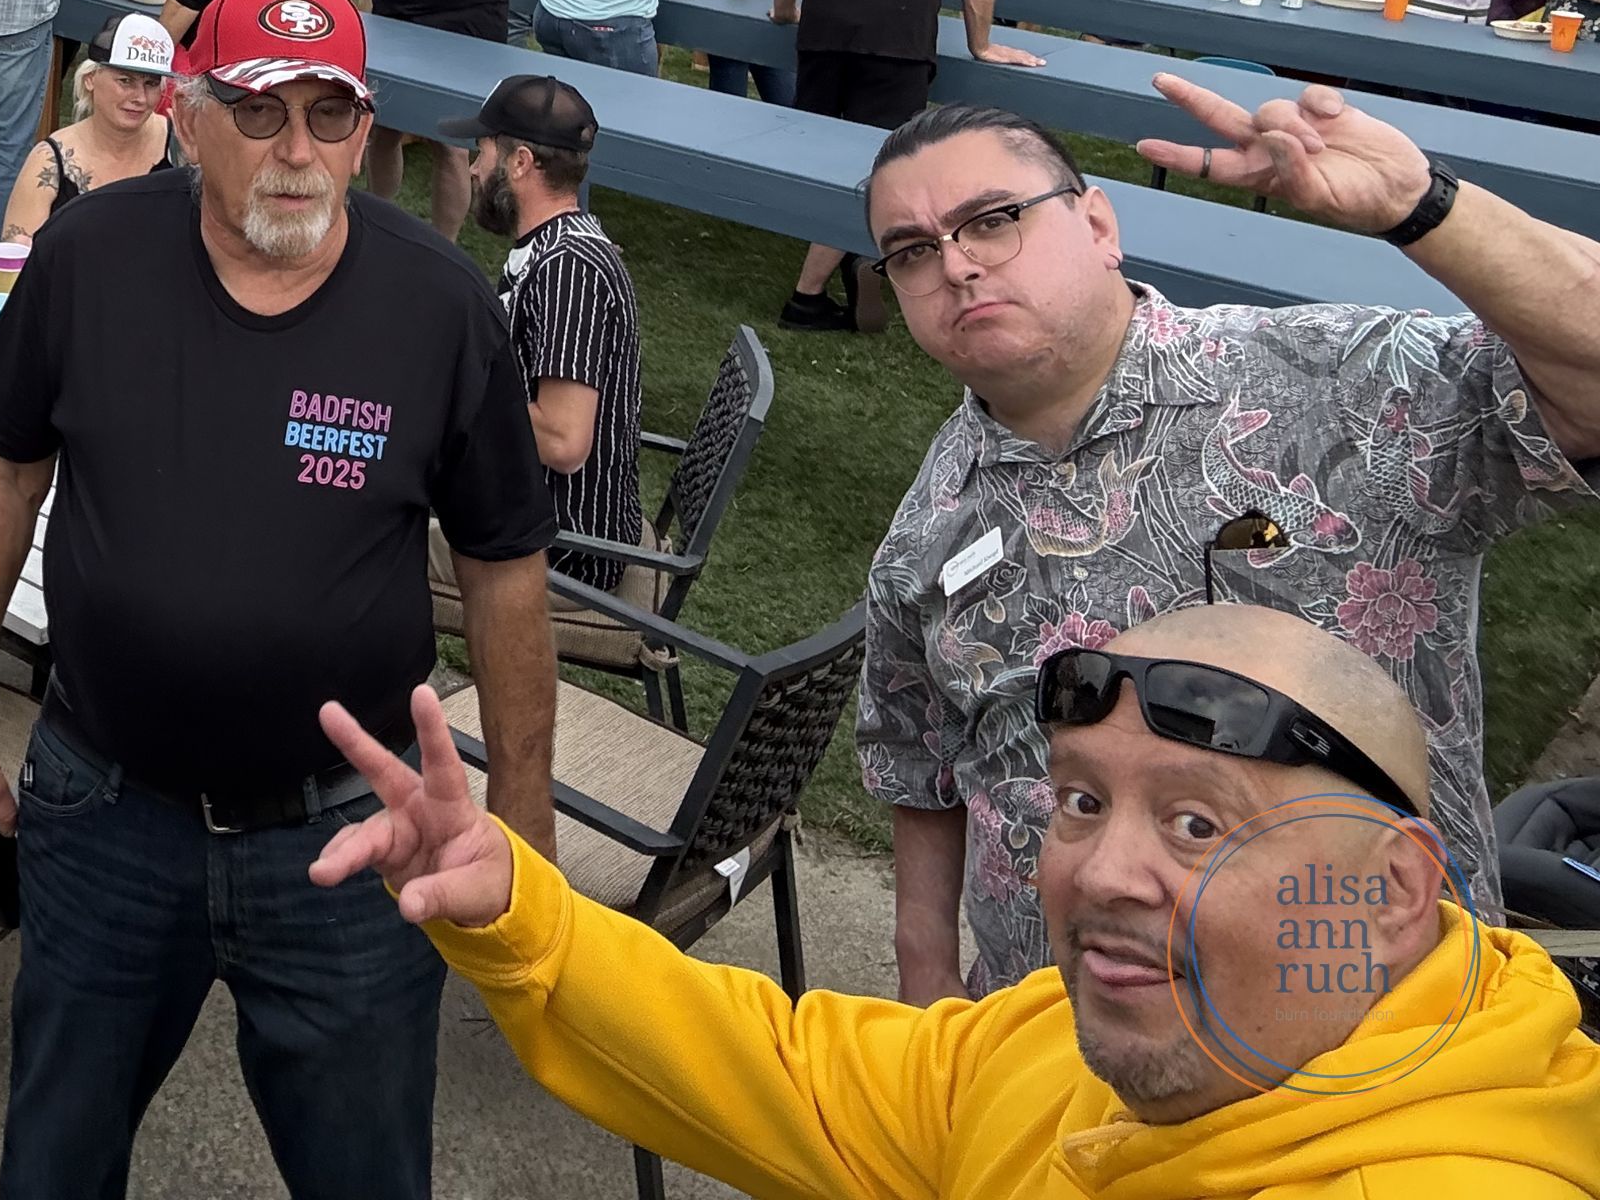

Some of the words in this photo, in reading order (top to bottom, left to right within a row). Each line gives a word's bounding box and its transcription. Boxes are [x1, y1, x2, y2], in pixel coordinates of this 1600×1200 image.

[280, 0, 323, 34] SF
[126, 46, 170, 66] Dakine
[289, 390, 392, 433] BADFISH
[284, 420, 388, 460] BEERFEST
[297, 453, 367, 490] 2025
